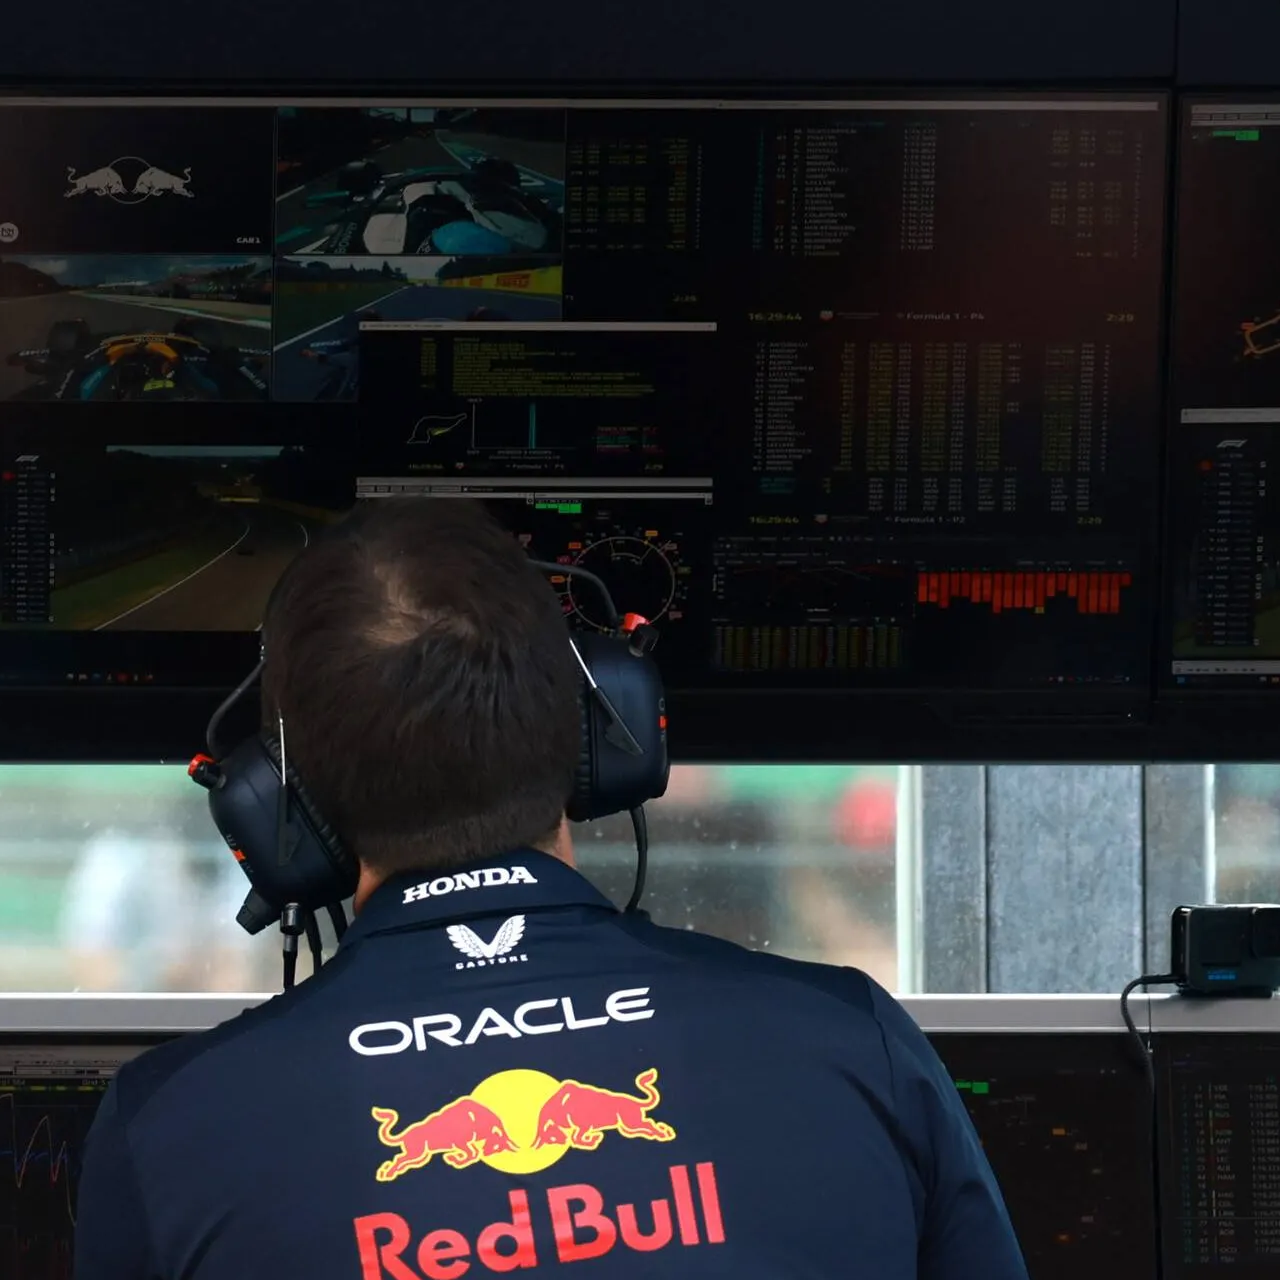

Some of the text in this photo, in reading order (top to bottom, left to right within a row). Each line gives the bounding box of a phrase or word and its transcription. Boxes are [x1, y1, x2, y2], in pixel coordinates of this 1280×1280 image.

[402, 866, 538, 904] HONDA
[455, 953, 529, 970] CASTORE
[348, 986, 656, 1057] ORACLE
[546, 1162, 726, 1263] Bull
